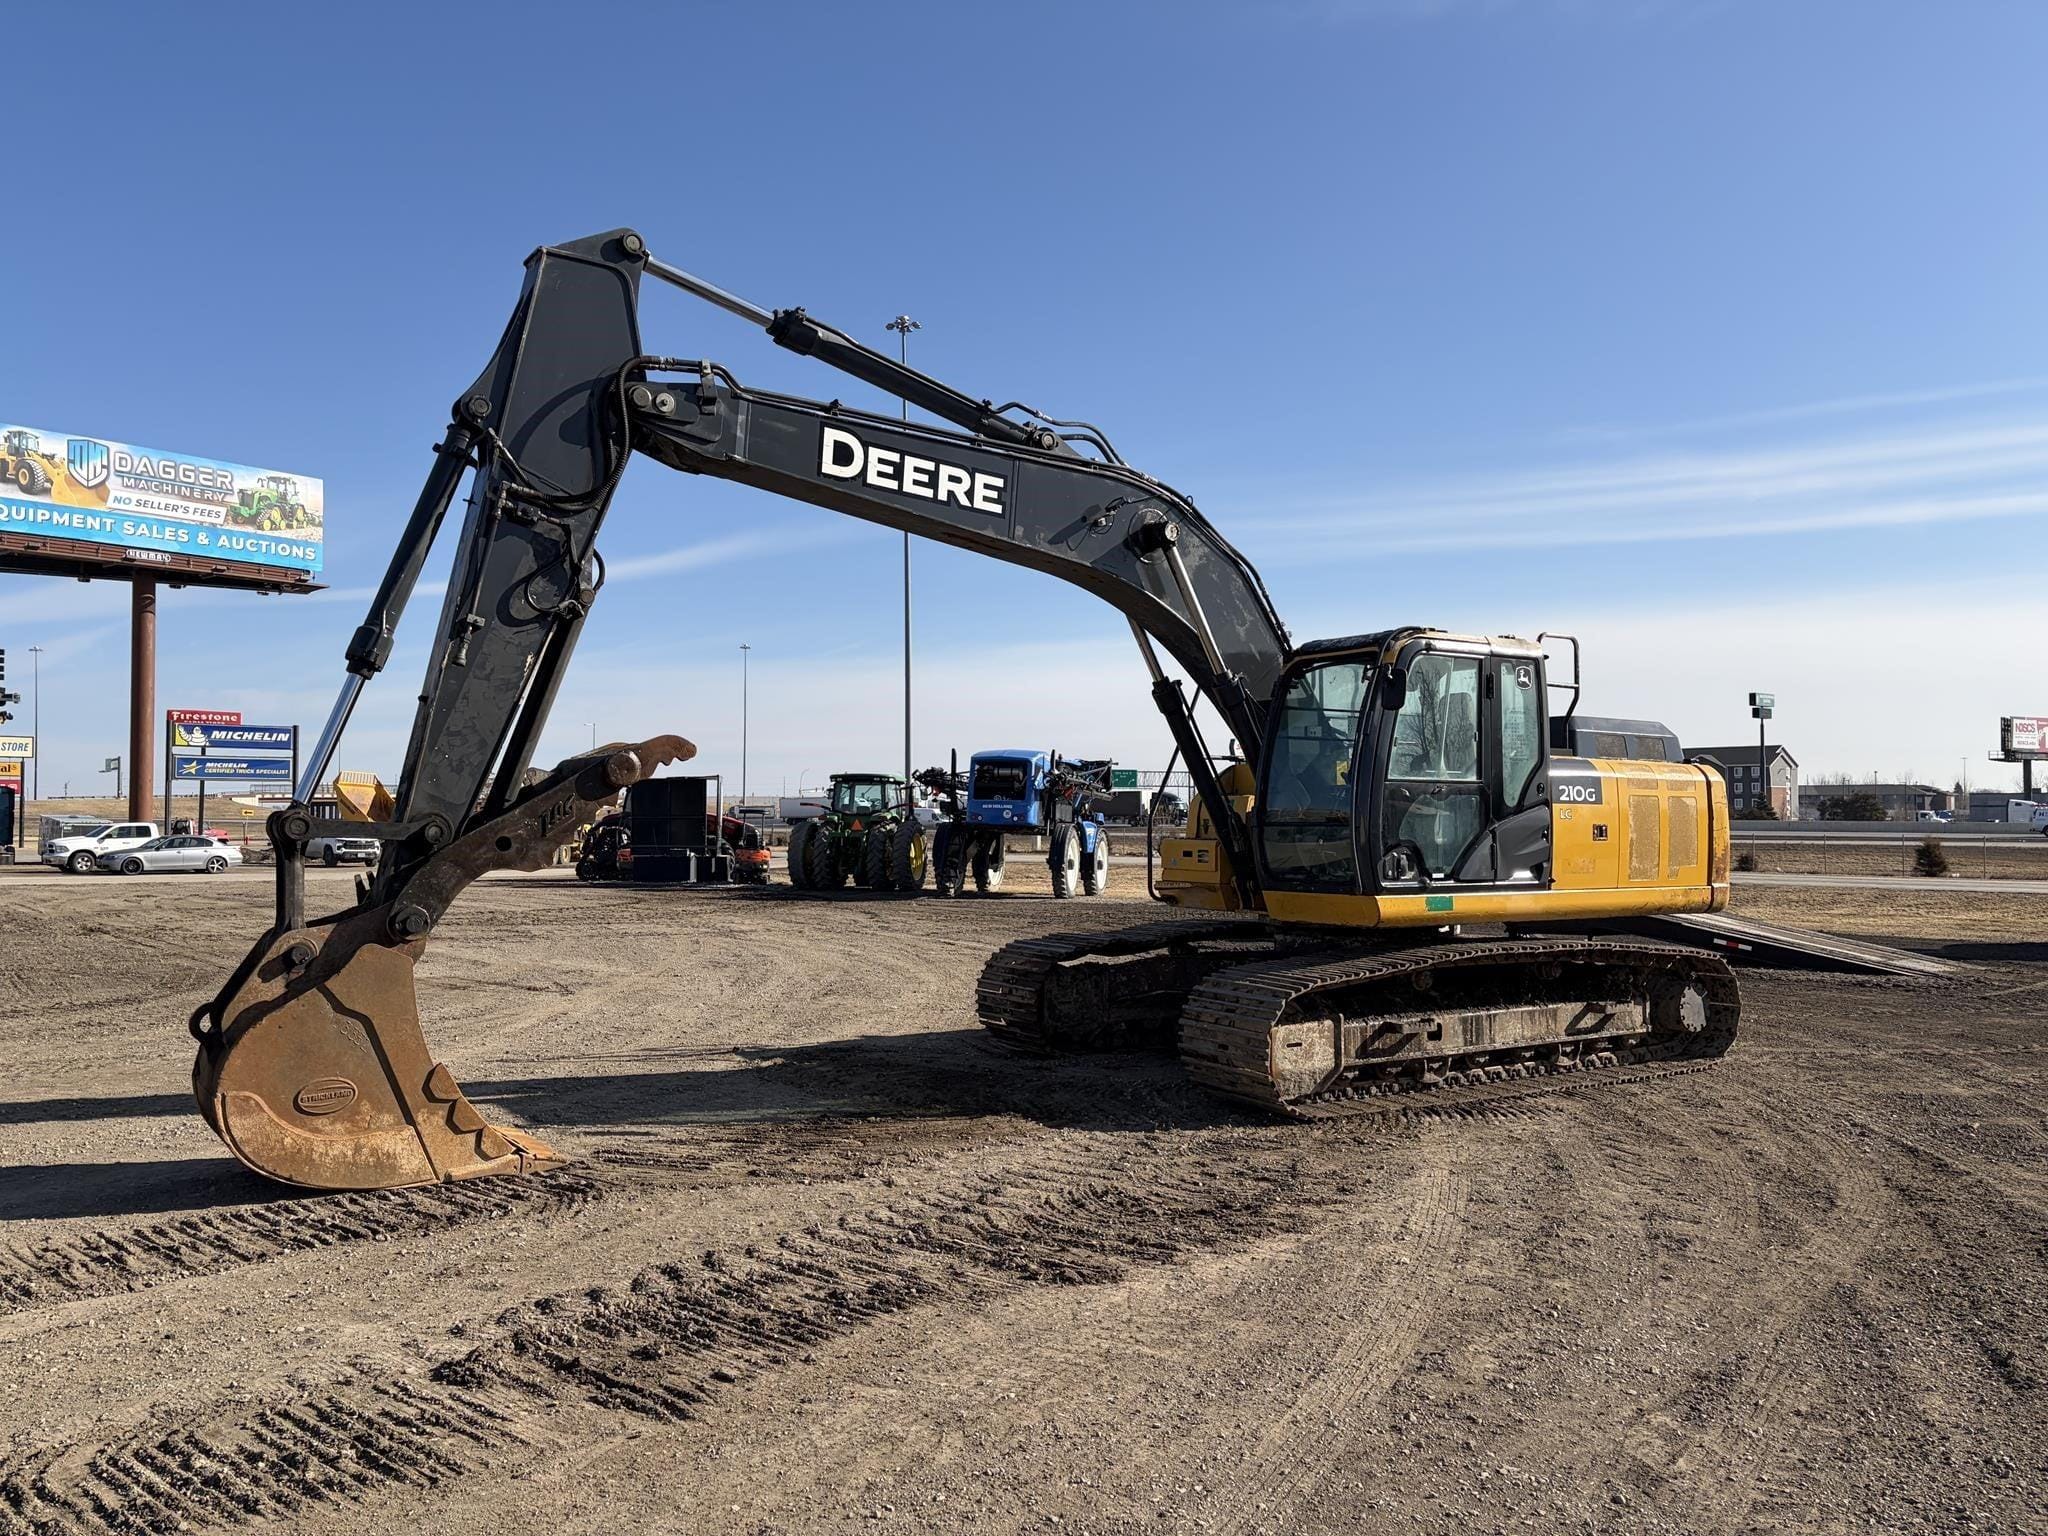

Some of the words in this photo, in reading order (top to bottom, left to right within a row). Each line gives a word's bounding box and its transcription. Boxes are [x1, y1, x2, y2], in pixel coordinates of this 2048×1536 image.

[114, 452, 233, 490] DAGGER
[820, 426, 1005, 514] DEERE
[123, 477, 225, 501] MACHINERY
[112, 495, 132, 506] NO
[134, 498, 190, 514] SELLER'S
[192, 507, 221, 519] FEES
[123, 521, 189, 542] SALES
[197, 532, 210, 545] &
[217, 535, 316, 560] AUCTIONS
[171, 711, 238, 722] Firestone
[210, 730, 290, 741] MICHELIN
[0, 742, 29, 752] STORE
[1558, 784, 1596, 802] 210G
[1560, 809, 1572, 819] LC
